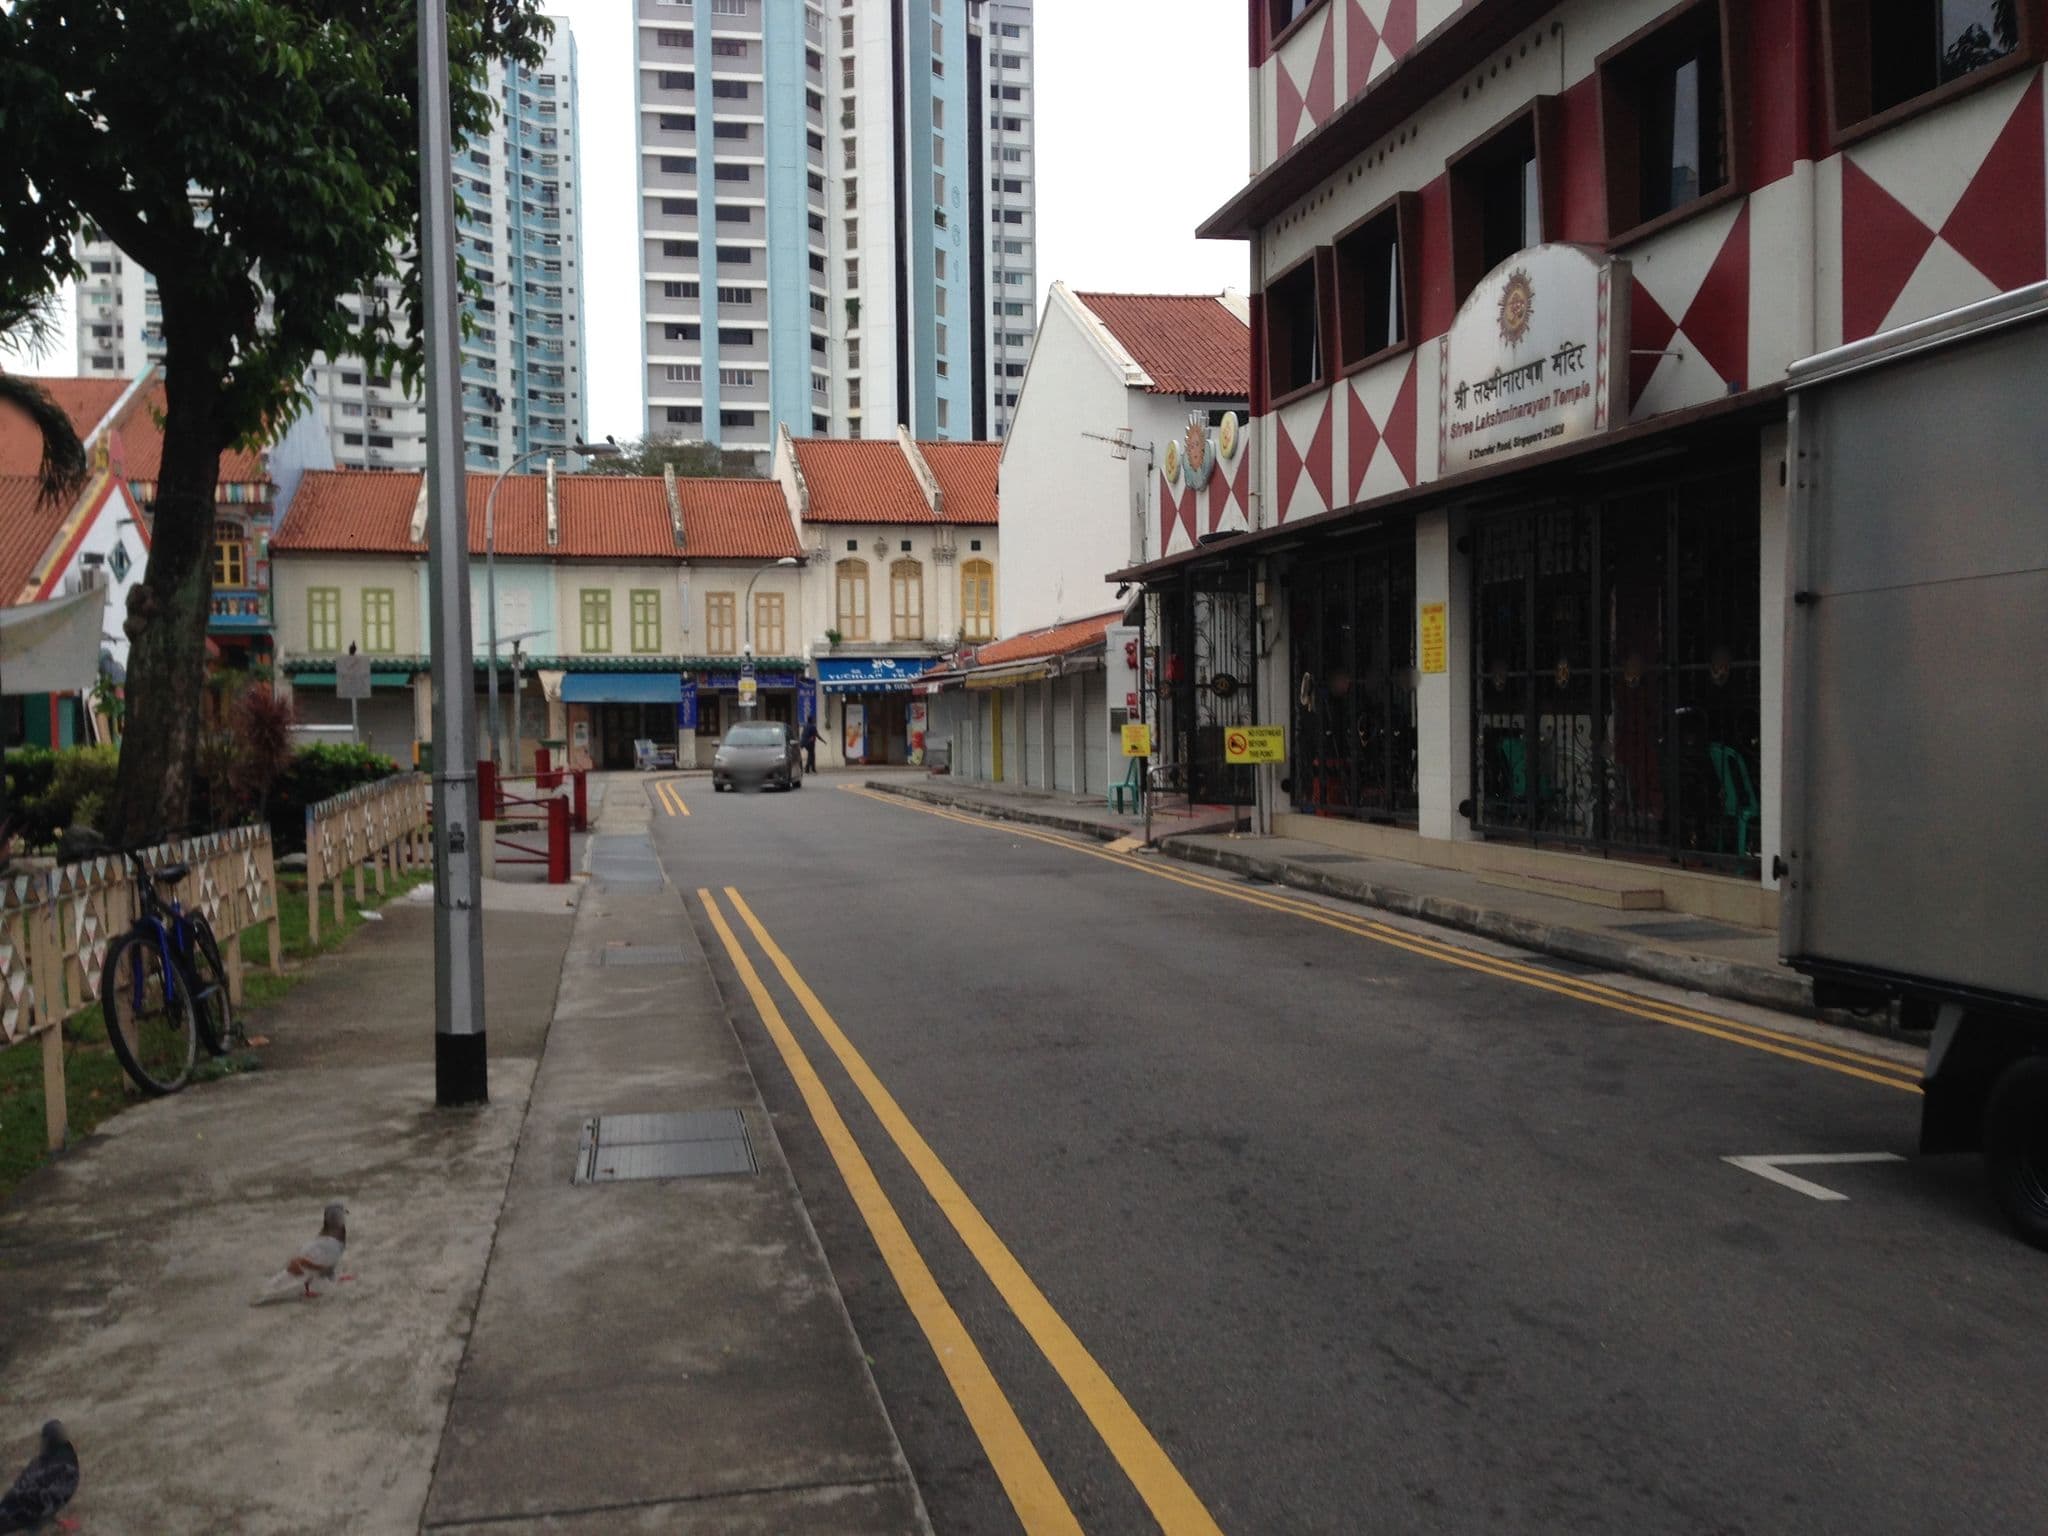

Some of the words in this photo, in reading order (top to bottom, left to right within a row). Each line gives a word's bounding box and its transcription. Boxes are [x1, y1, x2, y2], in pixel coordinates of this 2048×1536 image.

[1454, 380, 1470, 410] श्री
[1472, 366, 1547, 404] लक्ष्मीनारायण
[1551, 341, 1587, 376] मंदिर
[1450, 421, 1474, 439] Shree
[1475, 396, 1551, 431] Lakshminarayan
[1553, 380, 1591, 407] Temple
